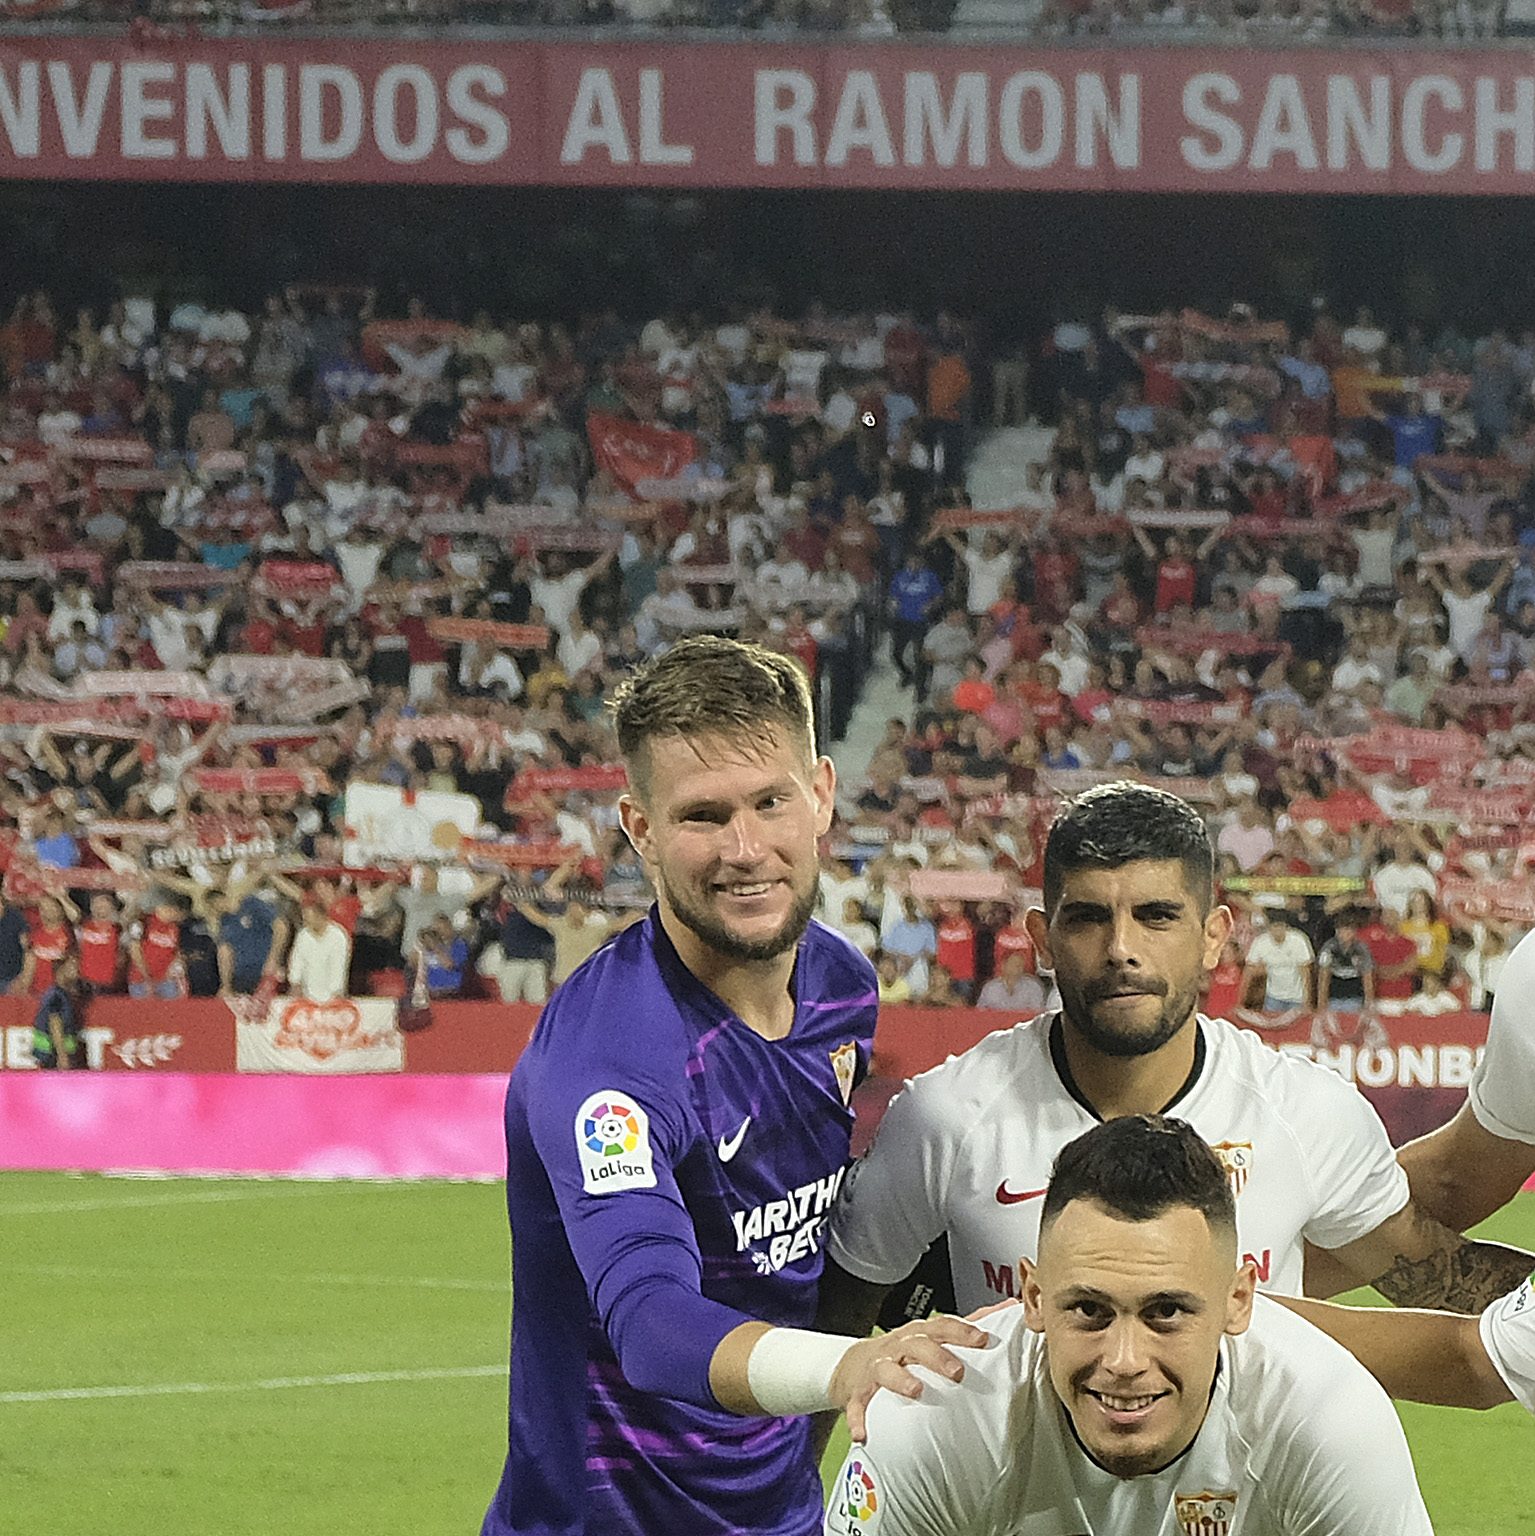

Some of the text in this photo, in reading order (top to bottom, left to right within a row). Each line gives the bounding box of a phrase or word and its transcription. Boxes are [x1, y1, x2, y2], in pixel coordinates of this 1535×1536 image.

[0, 60, 510, 165] NVENIDOS
[558, 67, 695, 166] AL
[753, 69, 1144, 171] RAMON
[590, 1159, 646, 1182] LaLiga
